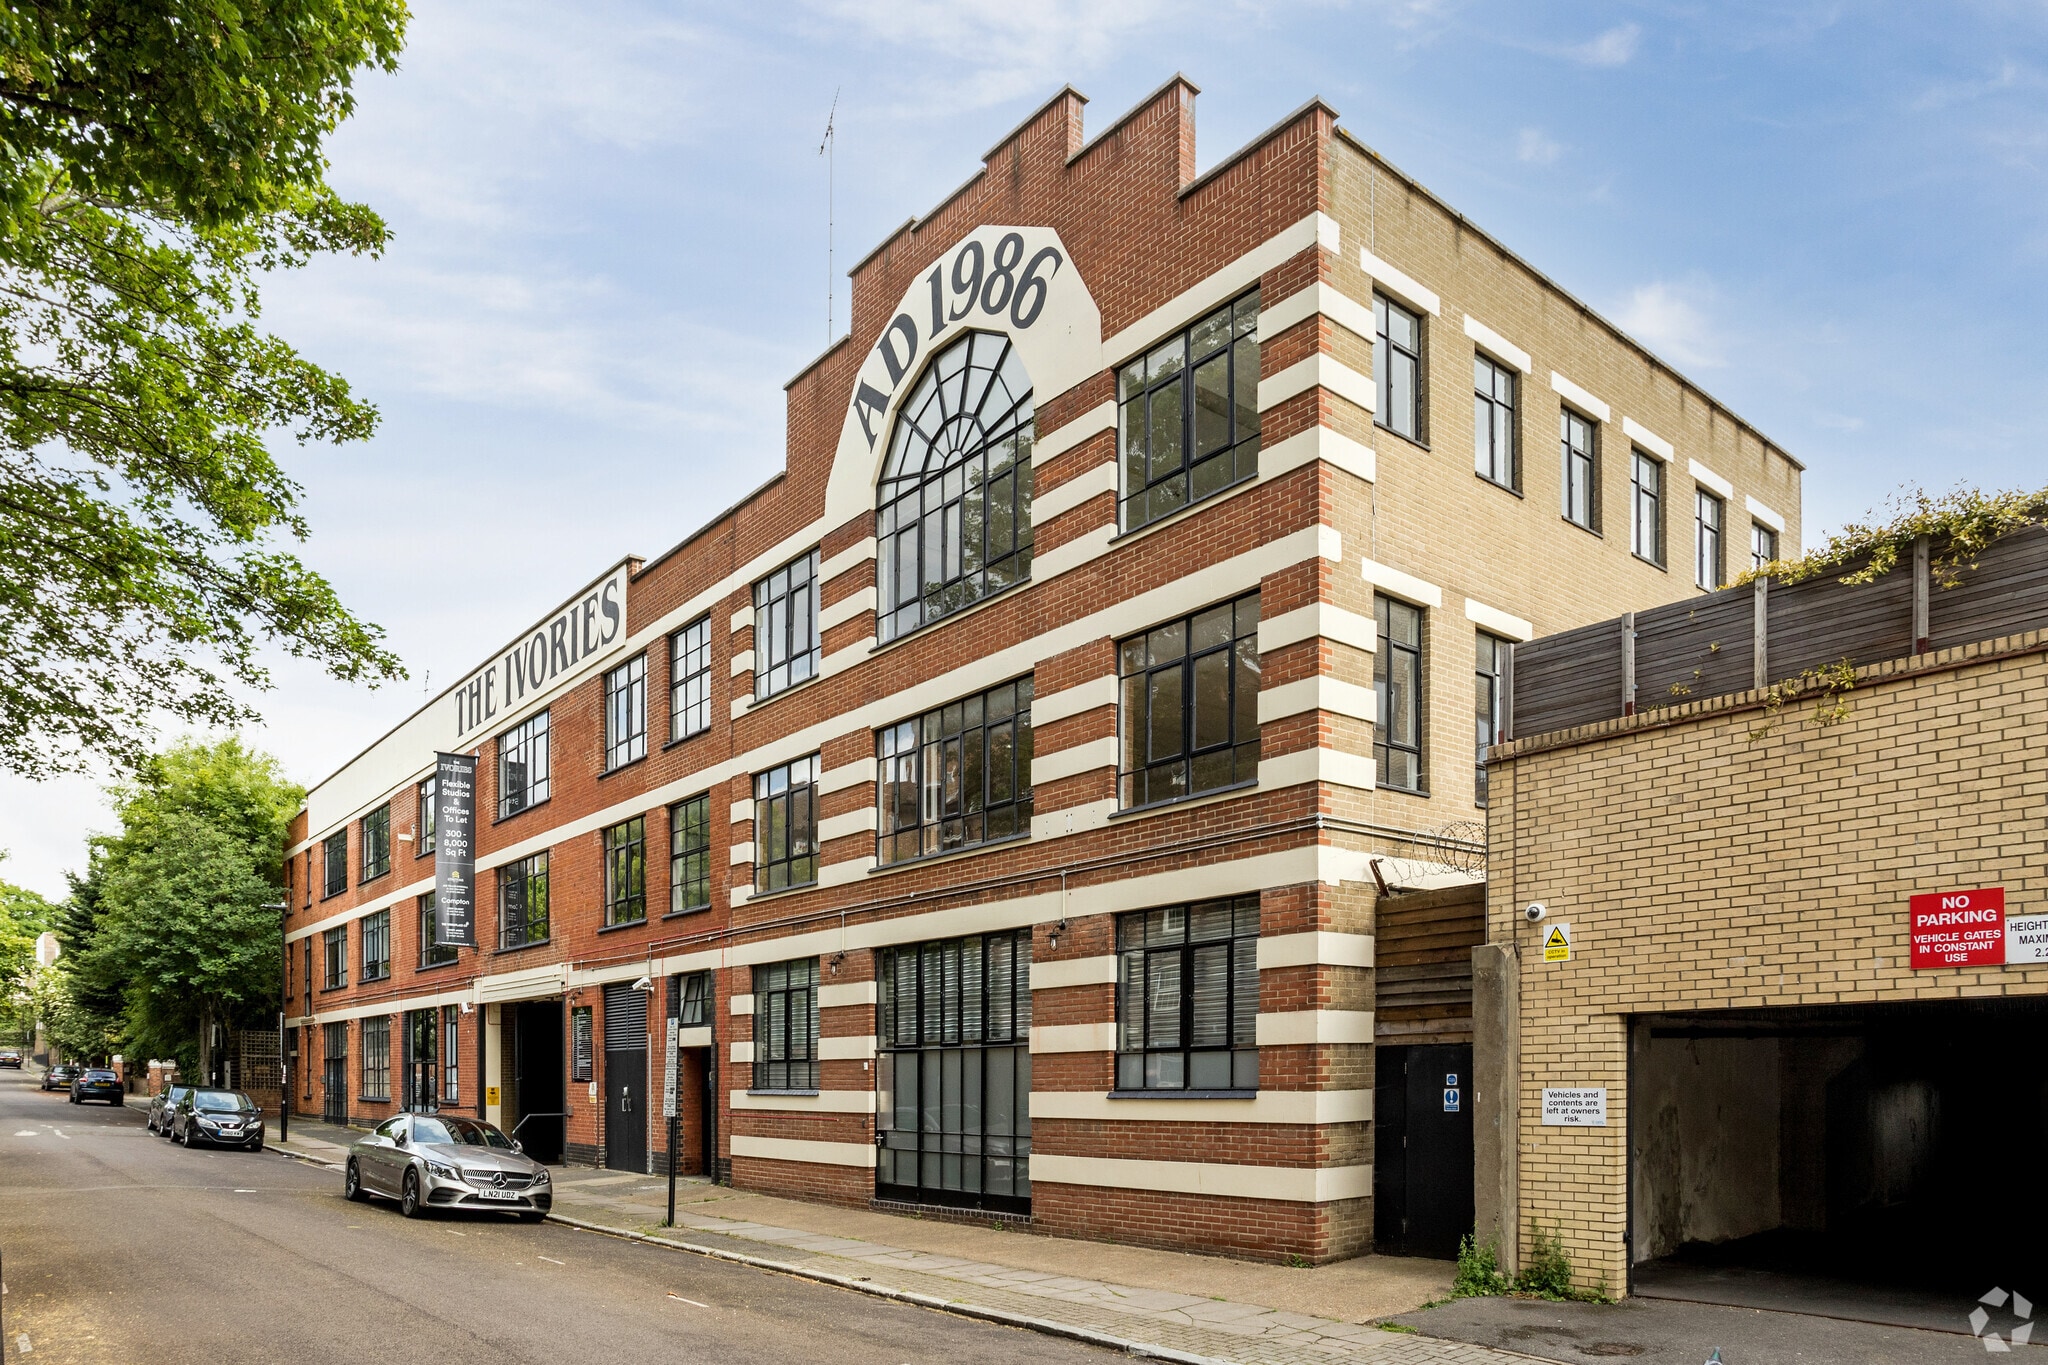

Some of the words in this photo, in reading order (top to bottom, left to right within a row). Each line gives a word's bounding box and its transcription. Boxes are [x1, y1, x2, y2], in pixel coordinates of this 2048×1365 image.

[926, 232, 1064, 341] 1986
[455, 665, 498, 738] THE
[504, 577, 620, 708] IVORIES
[441, 779, 471, 789] Flexible
[442, 788, 470, 798] Studios
[453, 798, 460, 806] &
[442, 805, 470, 815] Offices
[444, 815, 454, 823] To
[455, 815, 468, 824] Let
[443, 839, 468, 848] 8,000
[445, 848, 456, 857] Sq
[458, 849, 466, 857] Ft
[1942, 895, 1970, 909] NO
[1917, 909, 1997, 927] PARKING
[2010, 920, 2048, 932] HEIGHT
[1914, 932, 1960, 944] VEHICLE
[1963, 930, 2001, 940] GATES
[1919, 945, 1930, 954] IN
[1934, 941, 1995, 953] CONSTANT
[1945, 953, 1968, 963] USE
